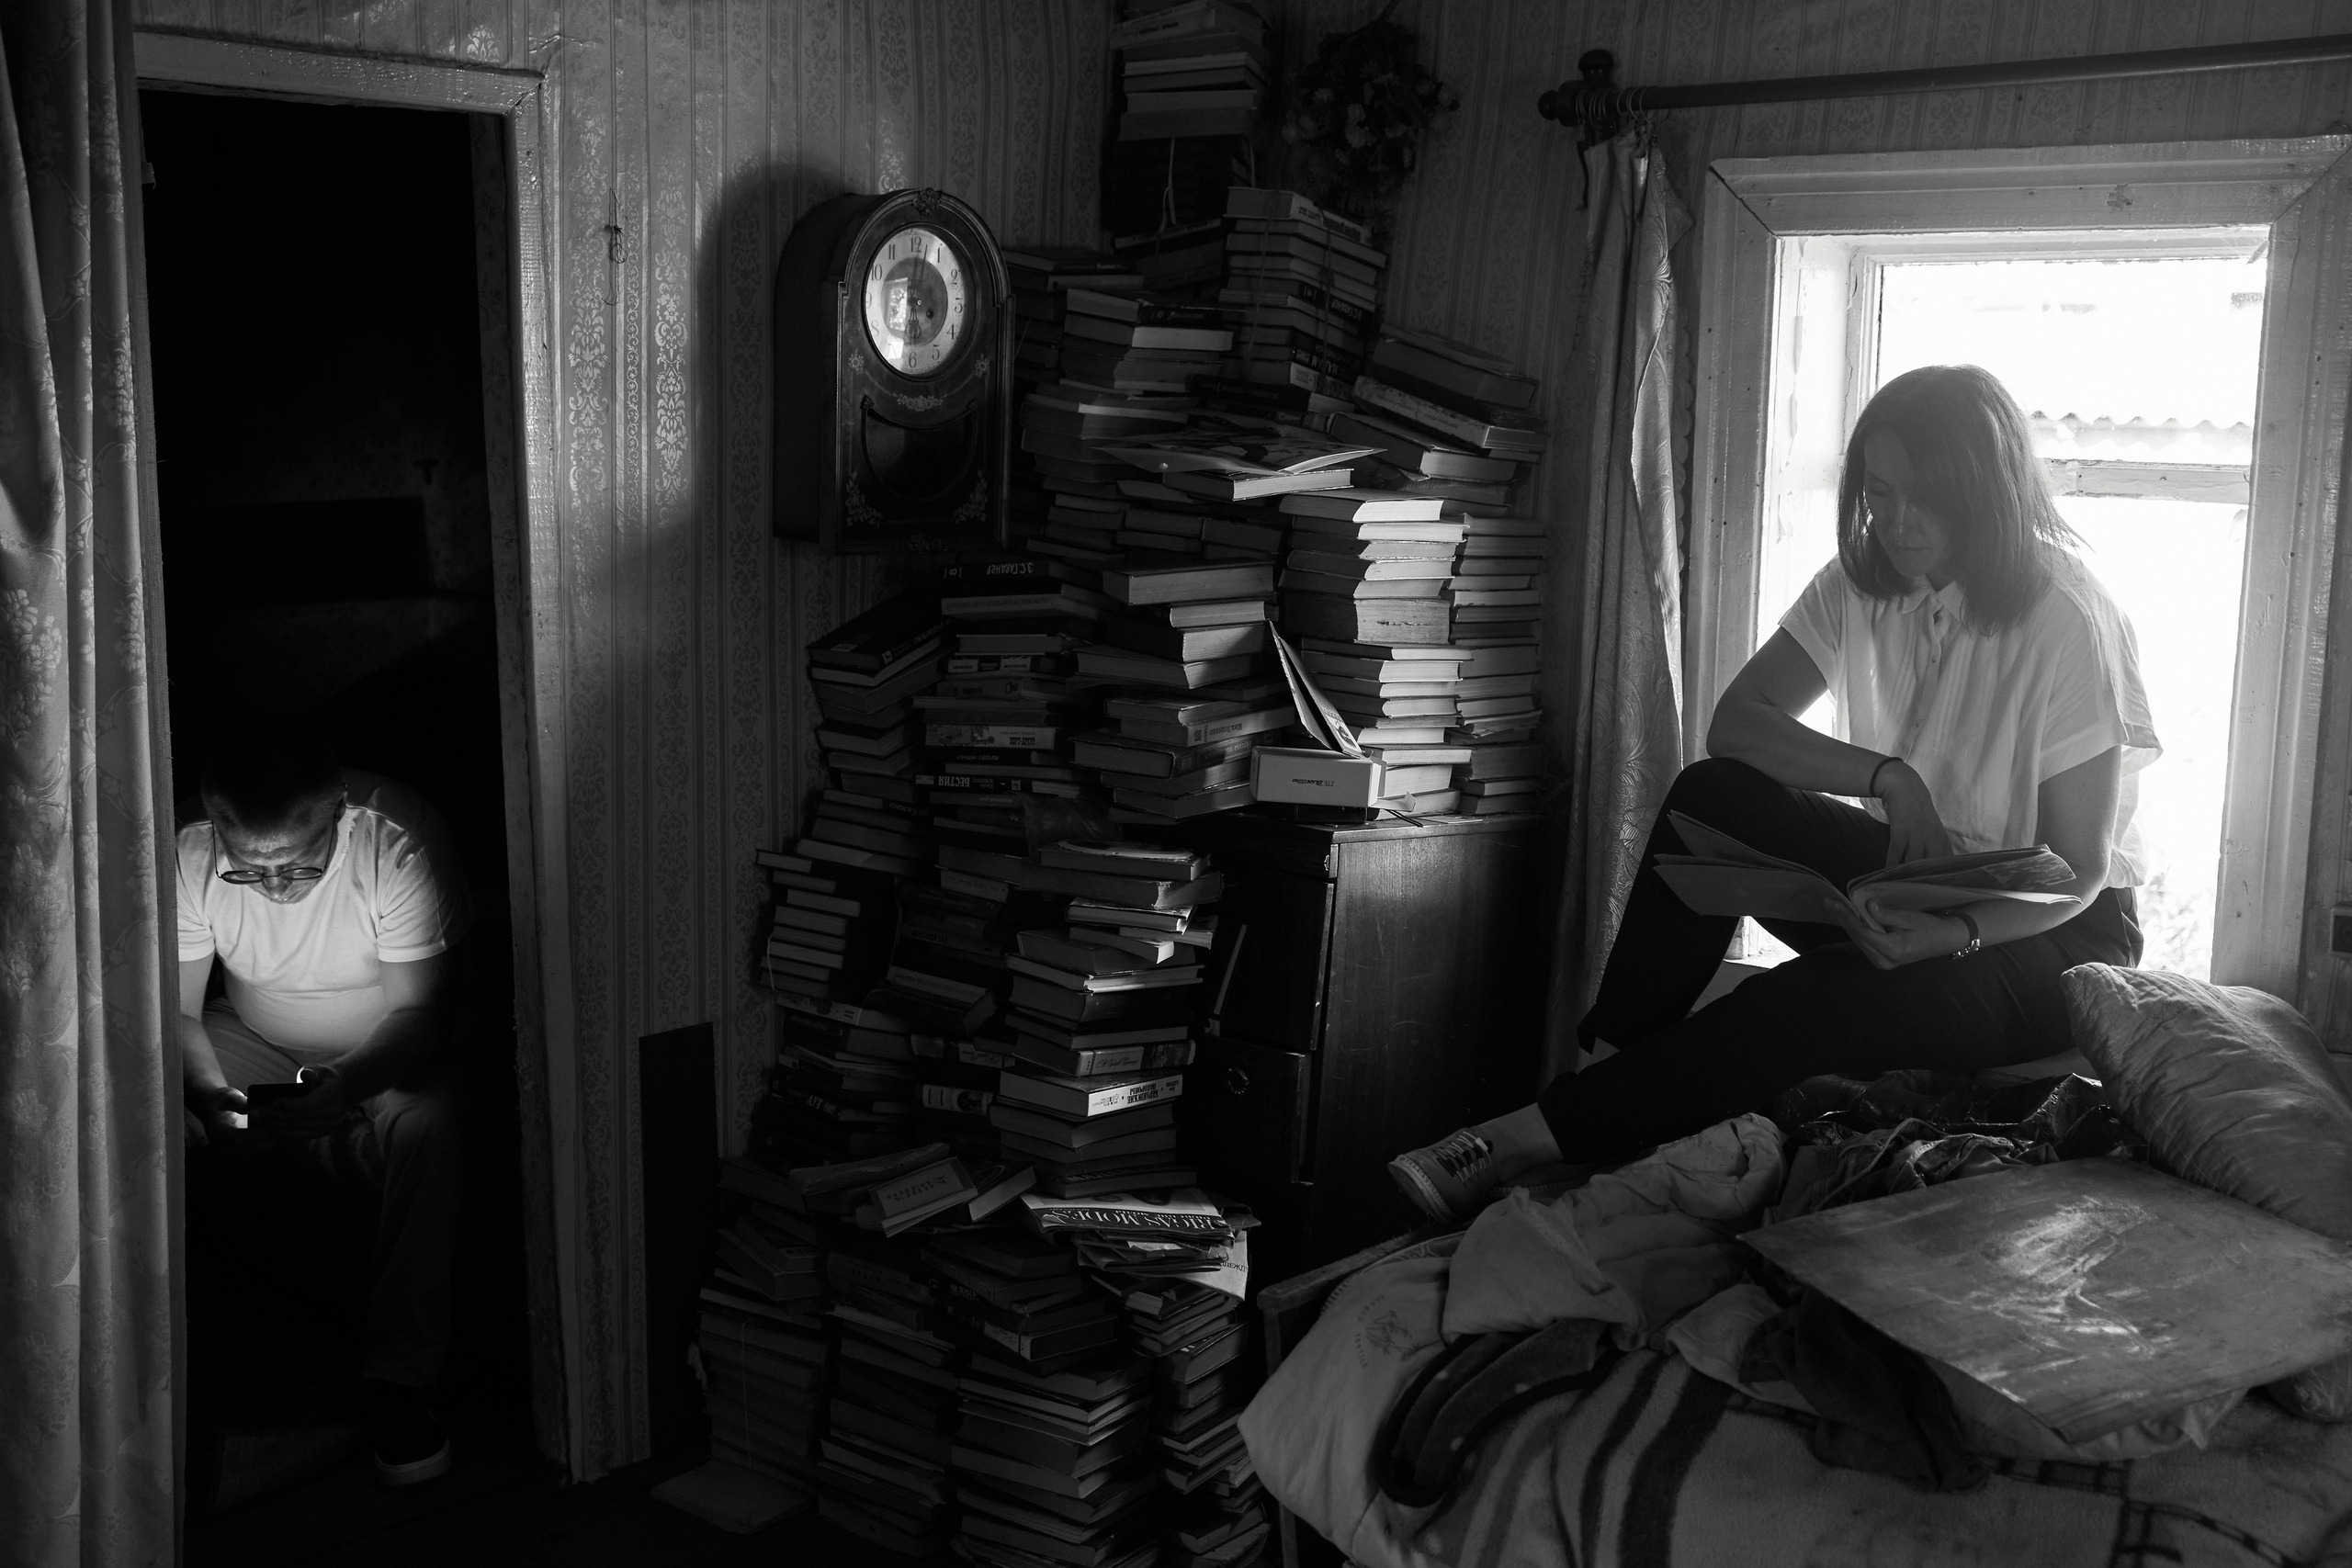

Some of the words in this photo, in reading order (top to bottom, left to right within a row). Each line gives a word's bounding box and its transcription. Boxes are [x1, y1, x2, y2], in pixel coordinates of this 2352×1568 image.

[888, 243, 896, 261] 11
[910, 236, 922, 254] 12
[936, 247, 942, 264] 1
[871, 264, 883, 281] 10
[950, 268, 958, 286] 2
[865, 291, 873, 309] 9
[954, 297, 963, 314] 3
[870, 320, 879, 337] 8
[946, 323, 956, 340] 4
[909, 351, 917, 368] 6
[932, 344, 941, 361] 5
[938, 775, 970, 788] БЕСТИЯ
